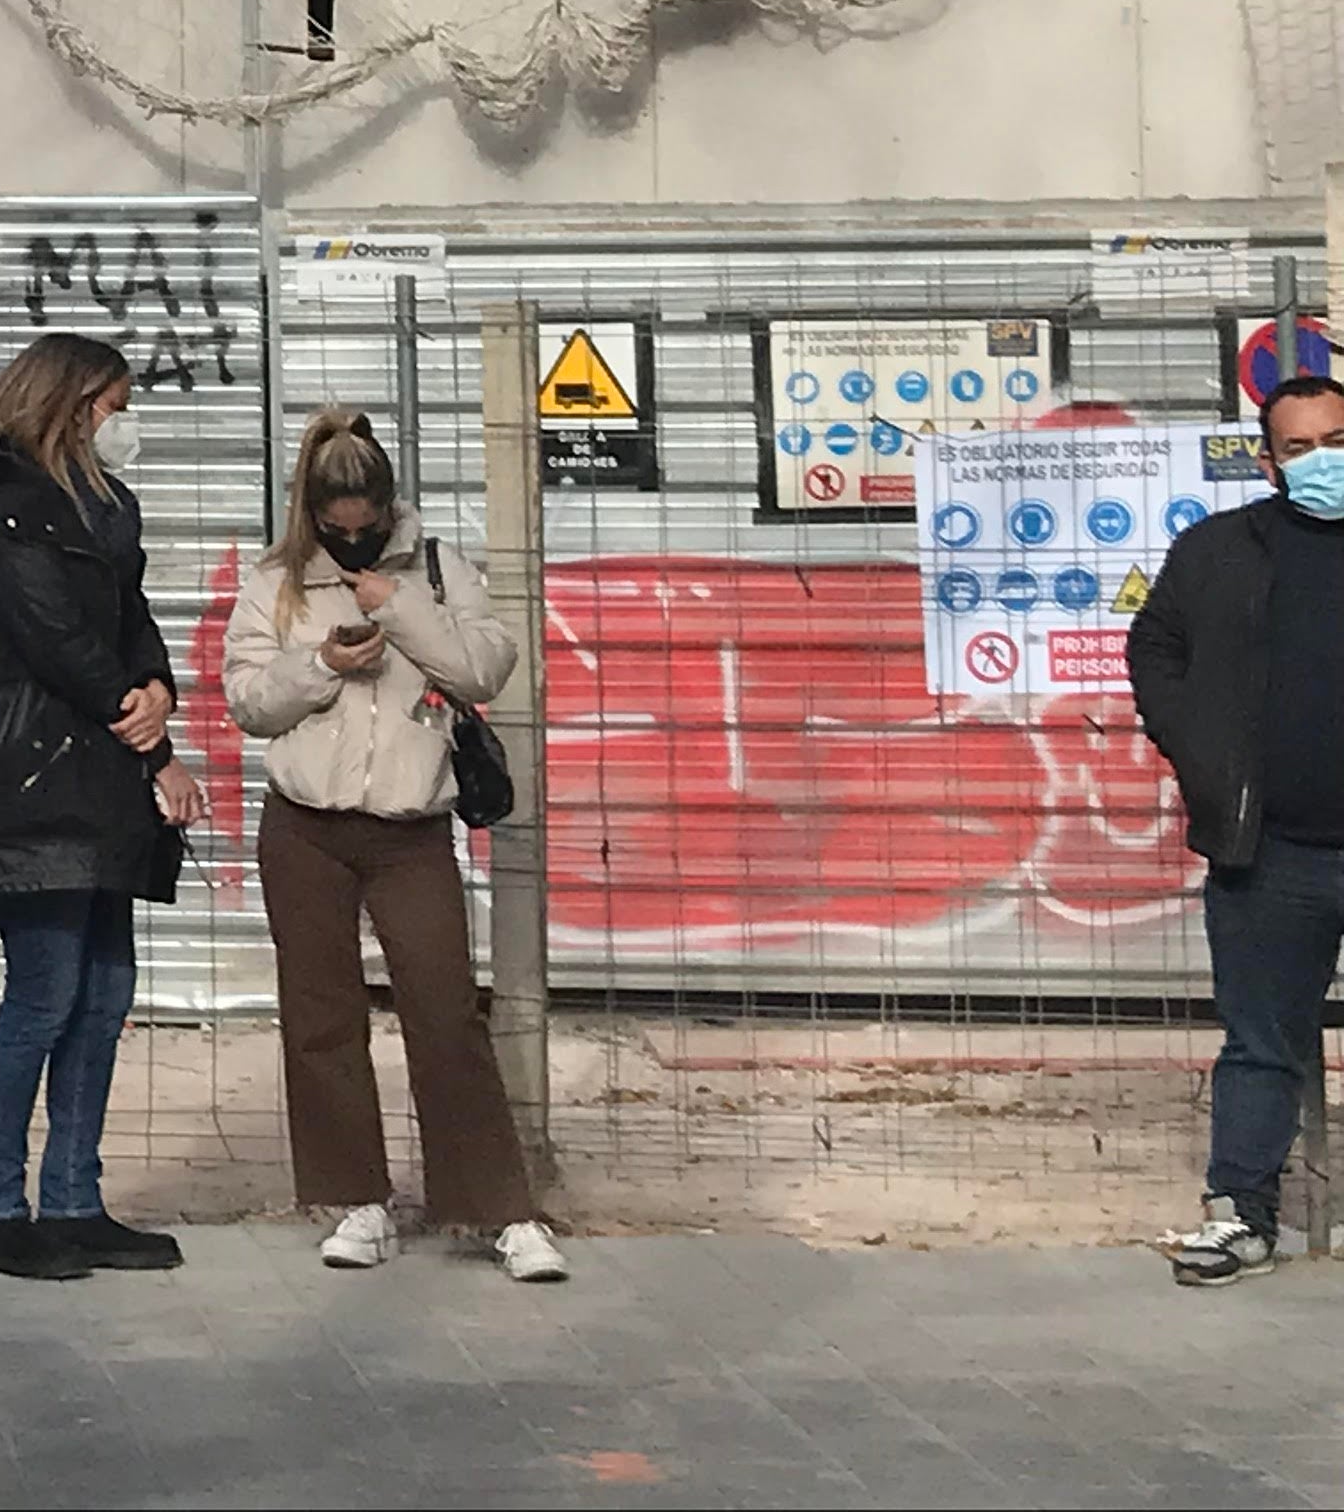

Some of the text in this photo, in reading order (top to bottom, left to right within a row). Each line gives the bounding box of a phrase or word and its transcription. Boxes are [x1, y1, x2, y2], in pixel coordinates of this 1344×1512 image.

[938, 439, 1172, 463] ES OBLIGATORIO SEGUIR TODAS
[1205, 436, 1264, 460] SPV
[951, 461, 1160, 483] LAS NORMAS DE SEGURIDAD
